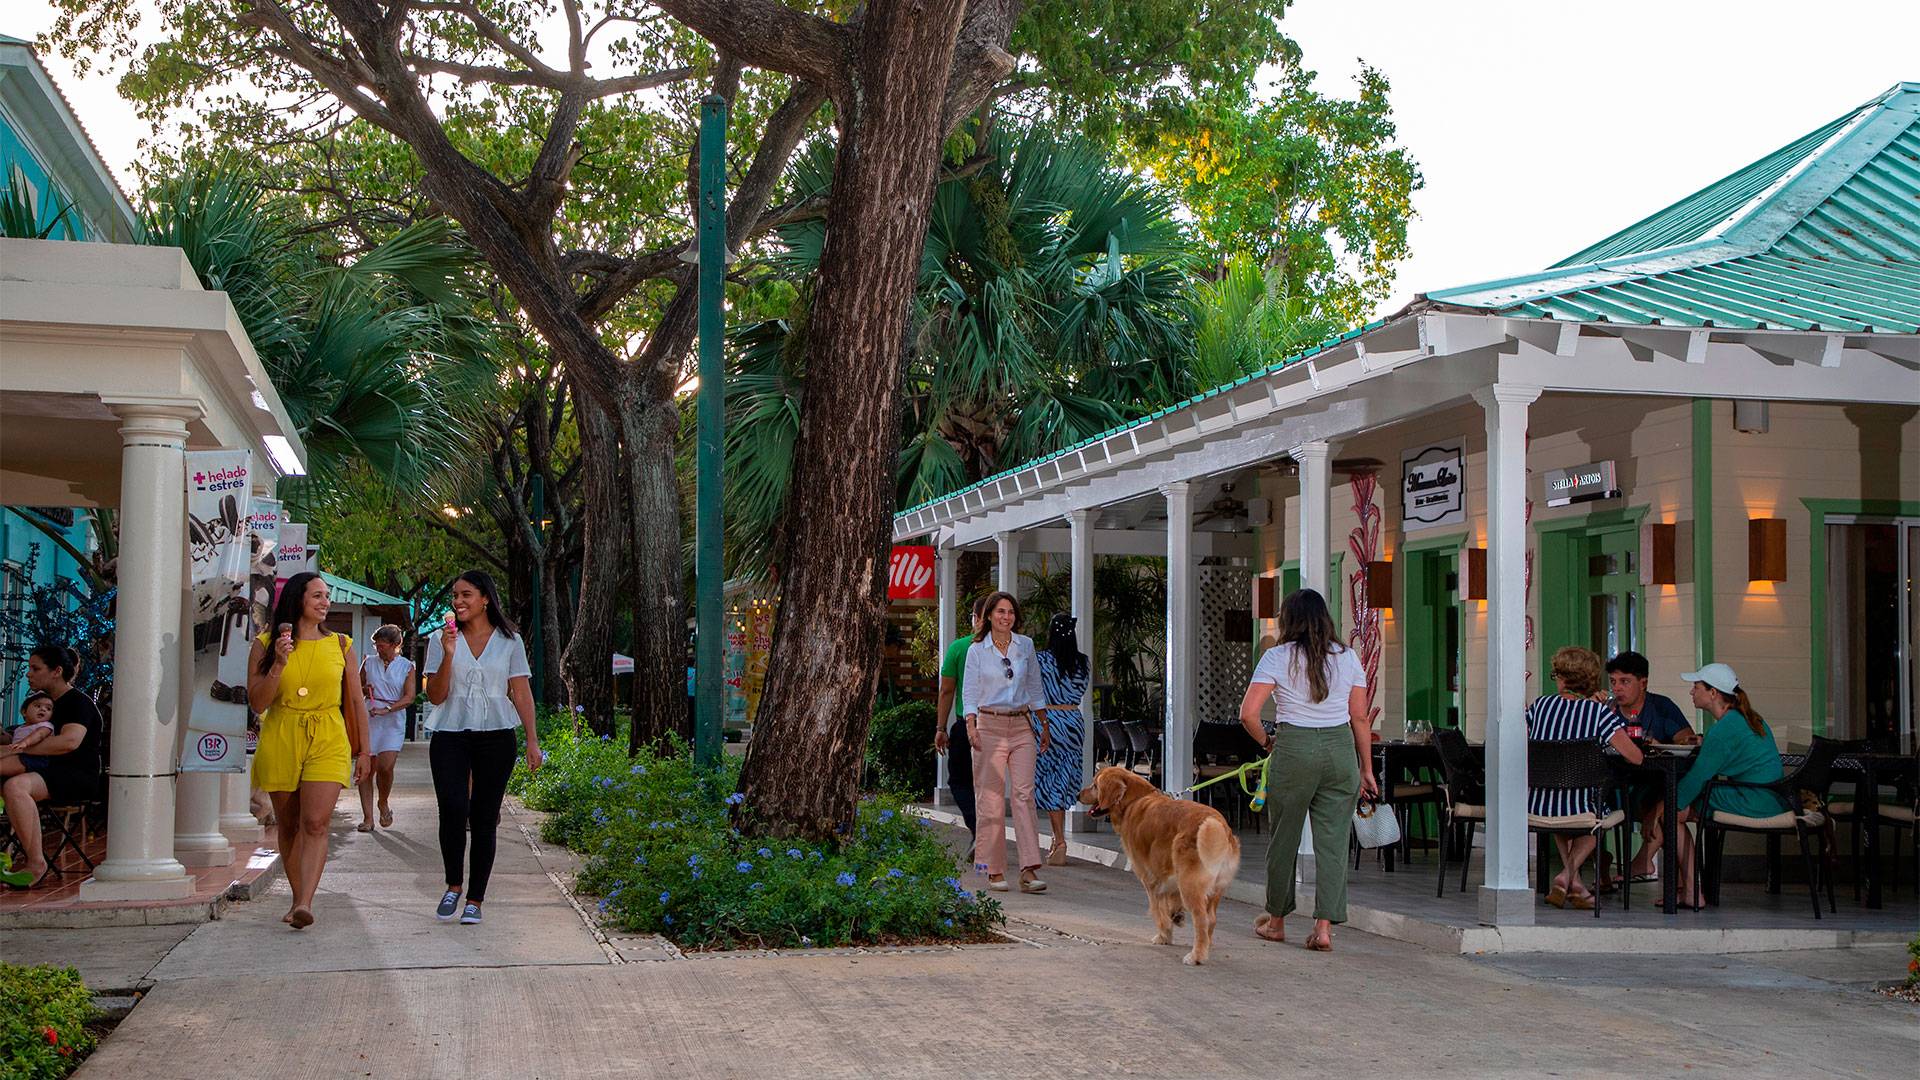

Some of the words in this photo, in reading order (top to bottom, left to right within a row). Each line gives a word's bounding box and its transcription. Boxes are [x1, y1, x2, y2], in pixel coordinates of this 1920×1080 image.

[208, 466, 247, 482] helado
[209, 478, 244, 492] estrés
[1552, 477, 1574, 490] STELLA
[250, 511, 277, 521] elado
[250, 520, 274, 529] strés
[279, 544, 303, 555] elado
[279, 552, 301, 561] strés
[889, 552, 932, 595] illy
[204, 738, 221, 749] BR
